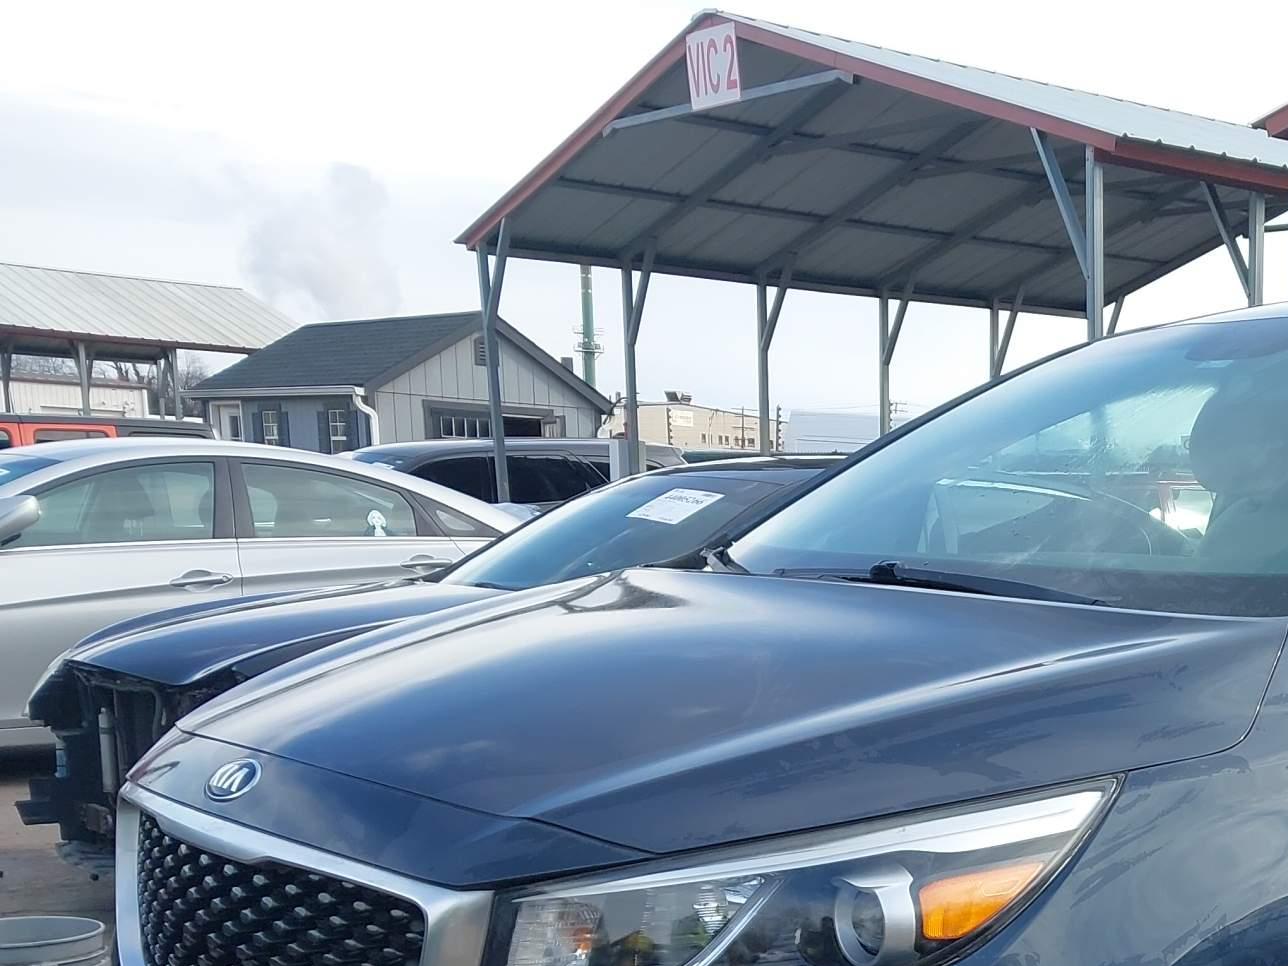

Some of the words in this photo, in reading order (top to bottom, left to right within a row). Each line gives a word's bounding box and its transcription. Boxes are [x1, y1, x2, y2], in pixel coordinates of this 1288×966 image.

[688, 38, 720, 97] VIC
[723, 34, 738, 90] 2
[208, 764, 250, 792] KIA
